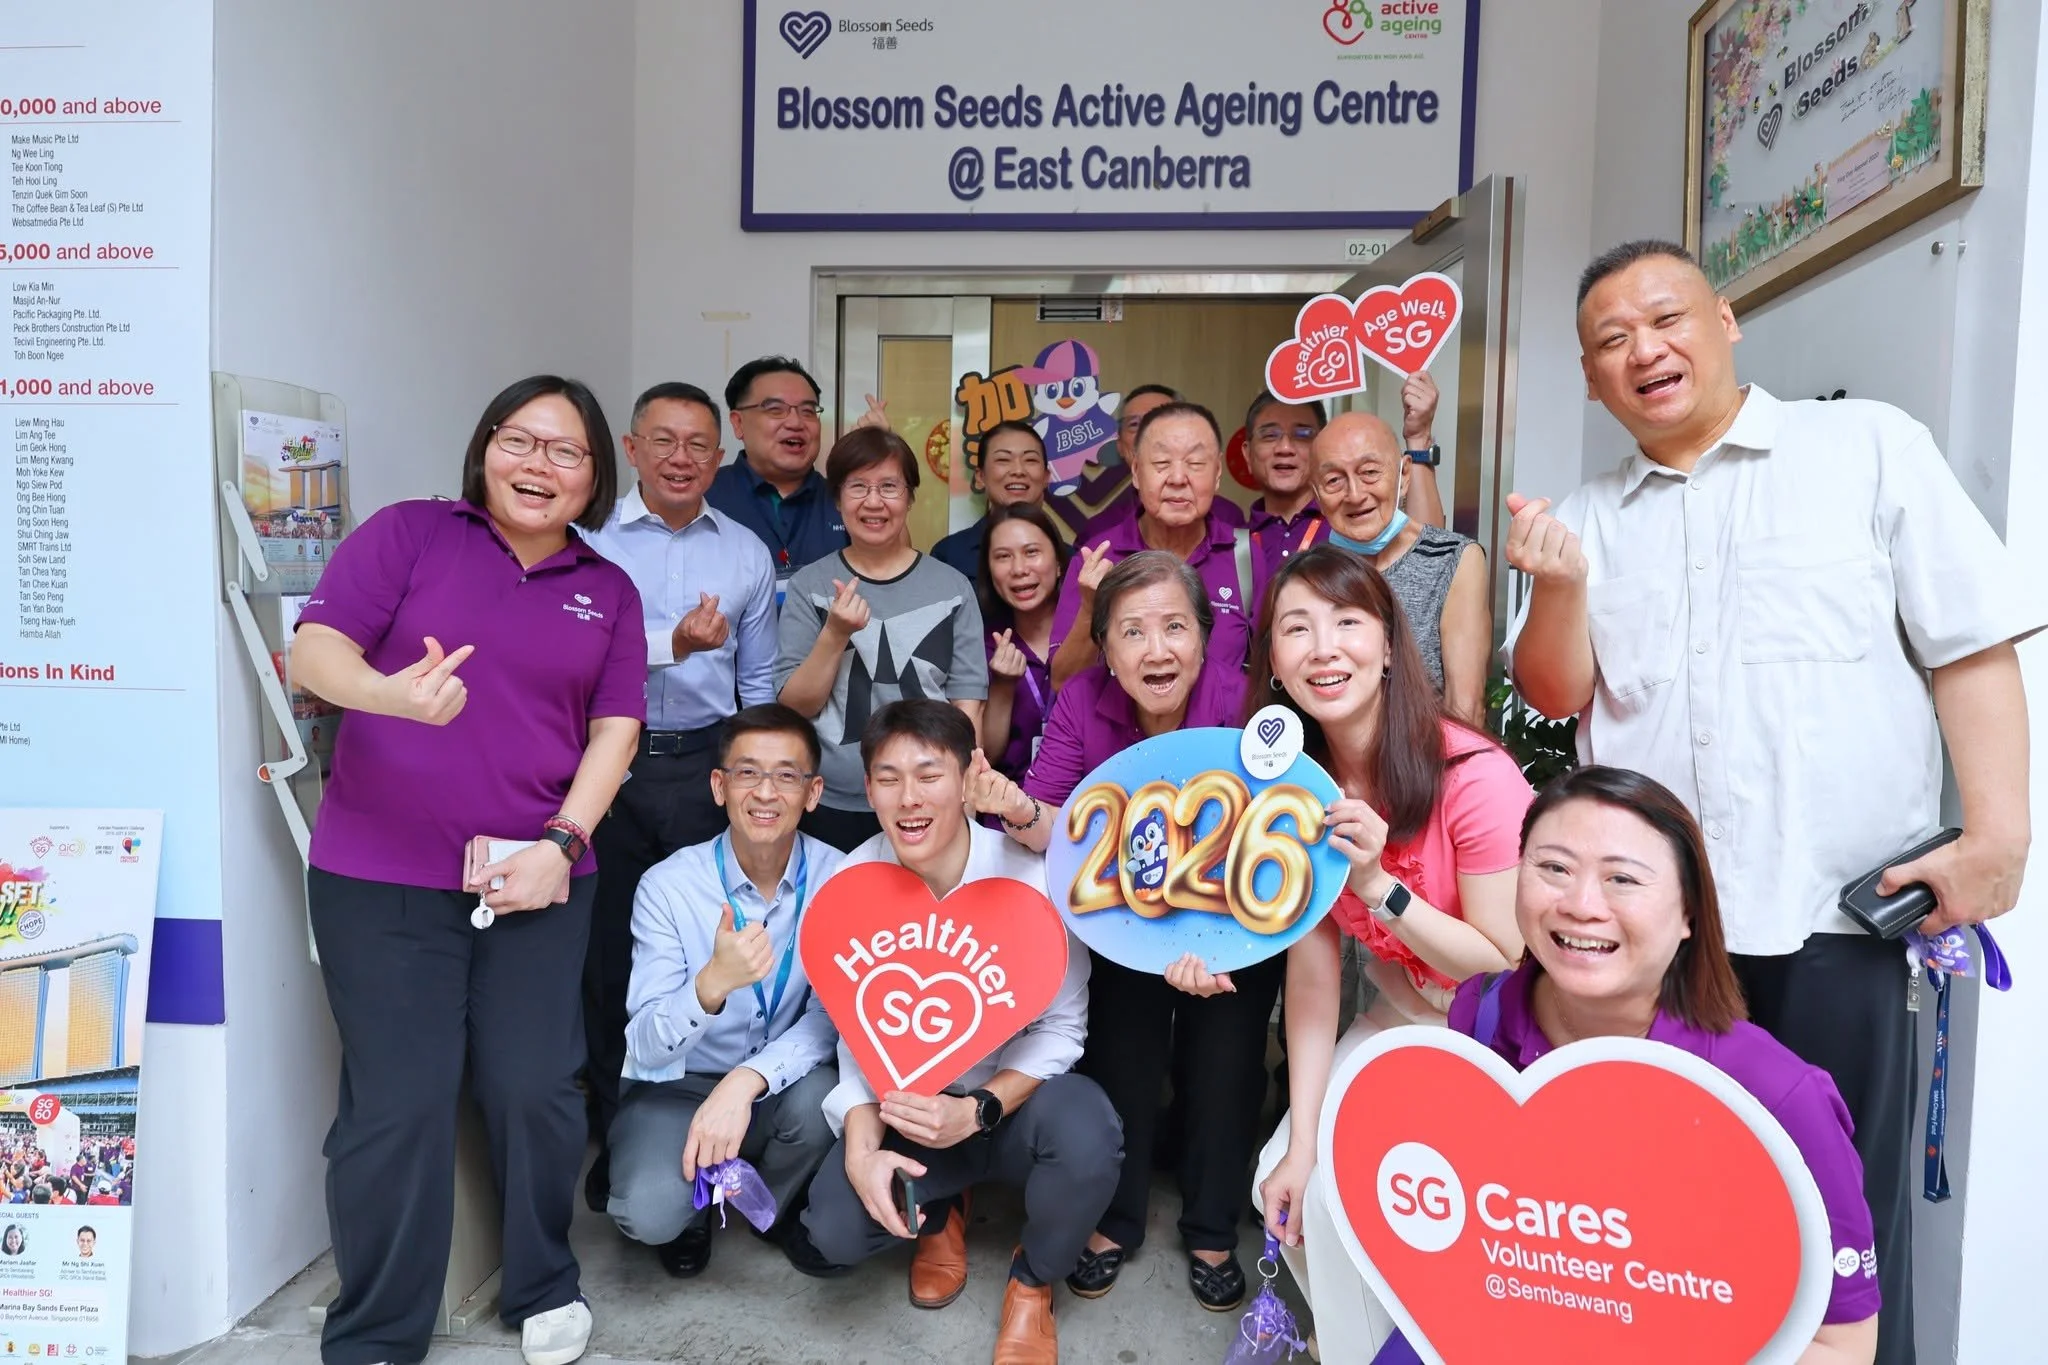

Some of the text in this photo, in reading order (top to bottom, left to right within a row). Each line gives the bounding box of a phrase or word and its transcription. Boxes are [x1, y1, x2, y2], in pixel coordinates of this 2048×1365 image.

[1381, 0, 1439, 15] active
[839, 18, 934, 32] Blossom Seeds
[1380, 17, 1442, 35] ageing
[872, 36, 898, 50] 福善
[1784, 1, 1873, 89] Blossom
[1797, 54, 1858, 118] Seeds
[0, 97, 162, 118] 0,000 and above
[777, 79, 1439, 137] Blossom Seeds Active Ageing Centre
[11, 134, 79, 145] Make Music Pte Ltd
[11, 148, 54, 161] Ng Wee Ling
[948, 145, 1250, 201] @ East Canberra
[11, 189, 88, 200] Tenzin Quek Gim Soon
[11, 202, 143, 215] The Coffee Bean & Tea Leaf (S) Pte Ltd
[11, 217, 84, 228] Websatmedia Pte Ltd
[56, 243, 90, 260] and
[97, 243, 154, 260] above
[1349, 243, 1388, 256] 02-01
[12, 282, 54, 293] Low Kia Min
[36, 295, 61, 306] An-Nur
[13, 309, 101, 321] Pacific Packaging Pte. Ltd.
[1363, 299, 1446, 337] Age Well
[13, 322, 130, 334] Peck Brothers Construction Pte Ltd
[36, 337, 76, 349] Engineering
[77, 336, 91, 347] Pte.
[92, 336, 105, 347] Ltd.
[1385, 321, 1432, 355] SG
[13, 350, 64, 363] Toh Boon Ngee
[1293, 324, 1349, 389] Healthier
[1319, 350, 1345, 382] SG
[58, 379, 92, 396] and
[98, 379, 154, 396] above
[32, 417, 50, 430] Ming
[51, 418, 65, 428] Hau
[15, 430, 56, 442] Lim Ang Tee
[1057, 420, 1104, 452] BSL
[15, 455, 74, 467] Lim Meng Kwang
[16, 467, 64, 478] Moh Yoke Kew
[31, 480, 48, 490] Siew
[16, 504, 65, 516] Ong Chin Tuan
[17, 517, 69, 529] Ong Soon Heng
[17, 529, 69, 541] Shui Ching Jaw
[17, 541, 72, 553] SMRT Trains Ltd
[32, 554, 48, 565] Sew
[48, 555, 66, 565] Land
[18, 566, 31, 577] Tan
[50, 567, 67, 579] Yang
[18, 578, 68, 590] Tan Chee Kuan
[19, 603, 63, 614] Tan Yan Boon
[46, 664, 63, 679] In
[70, 664, 115, 681] Kind
[9, 722, 21, 732] Ltd
[9, 736, 31, 746] Home)
[1067, 769, 1326, 935] 2026
[20, 917, 43, 932] CHOPE
[833, 913, 1016, 1009] Healthier
[877, 990, 953, 1043] SG
[36, 1099, 54, 1109] SG
[34, 1109, 52, 1120] 60
[1390, 1172, 1633, 1249] SG Cares
[1839, 1255, 1857, 1270] SG
[1480, 1238, 1734, 1304] Volunteer Centre
[3, 1289, 53, 1298] Healthier SG!
[1485, 1273, 1633, 1324] @Sembawang
[22, 1304, 35, 1312] Bay
